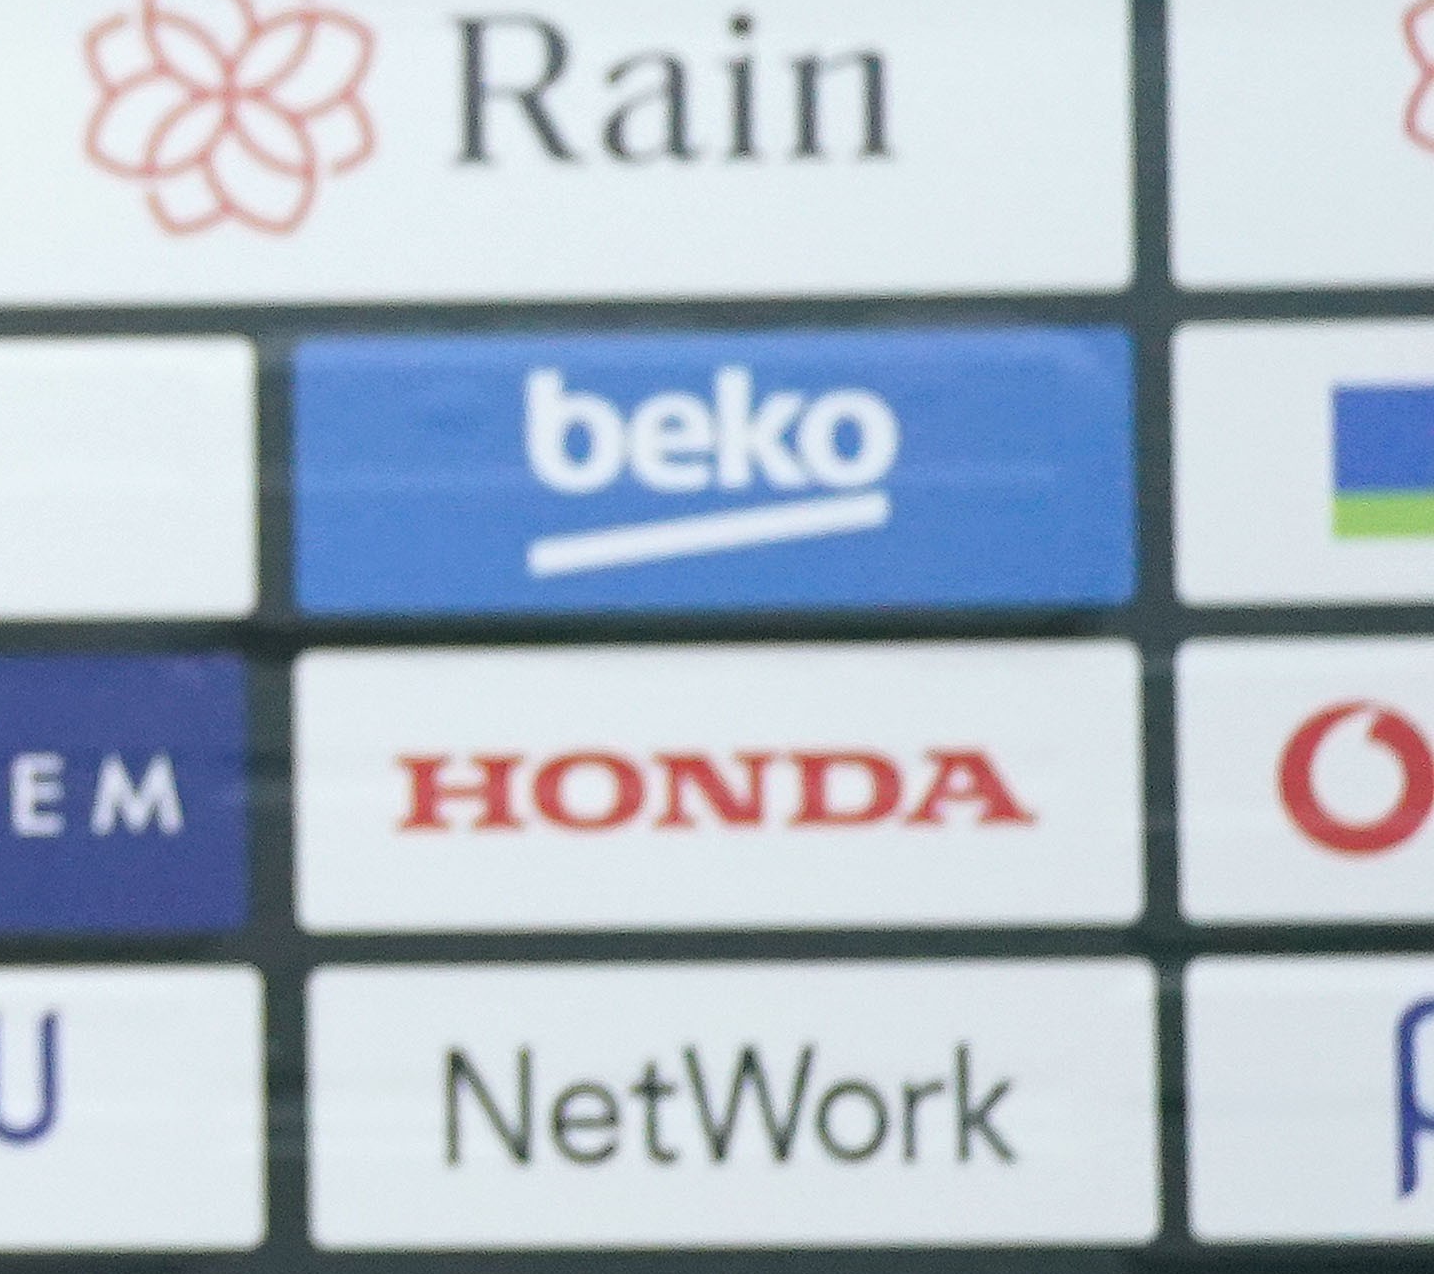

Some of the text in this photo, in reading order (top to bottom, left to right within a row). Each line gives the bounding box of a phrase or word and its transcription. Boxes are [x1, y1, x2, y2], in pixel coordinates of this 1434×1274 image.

[456, 12, 890, 165] Rain
[525, 365, 899, 501] beko
[399, 748, 1035, 833] HONDA
[443, 1043, 1016, 1167] NetWork
